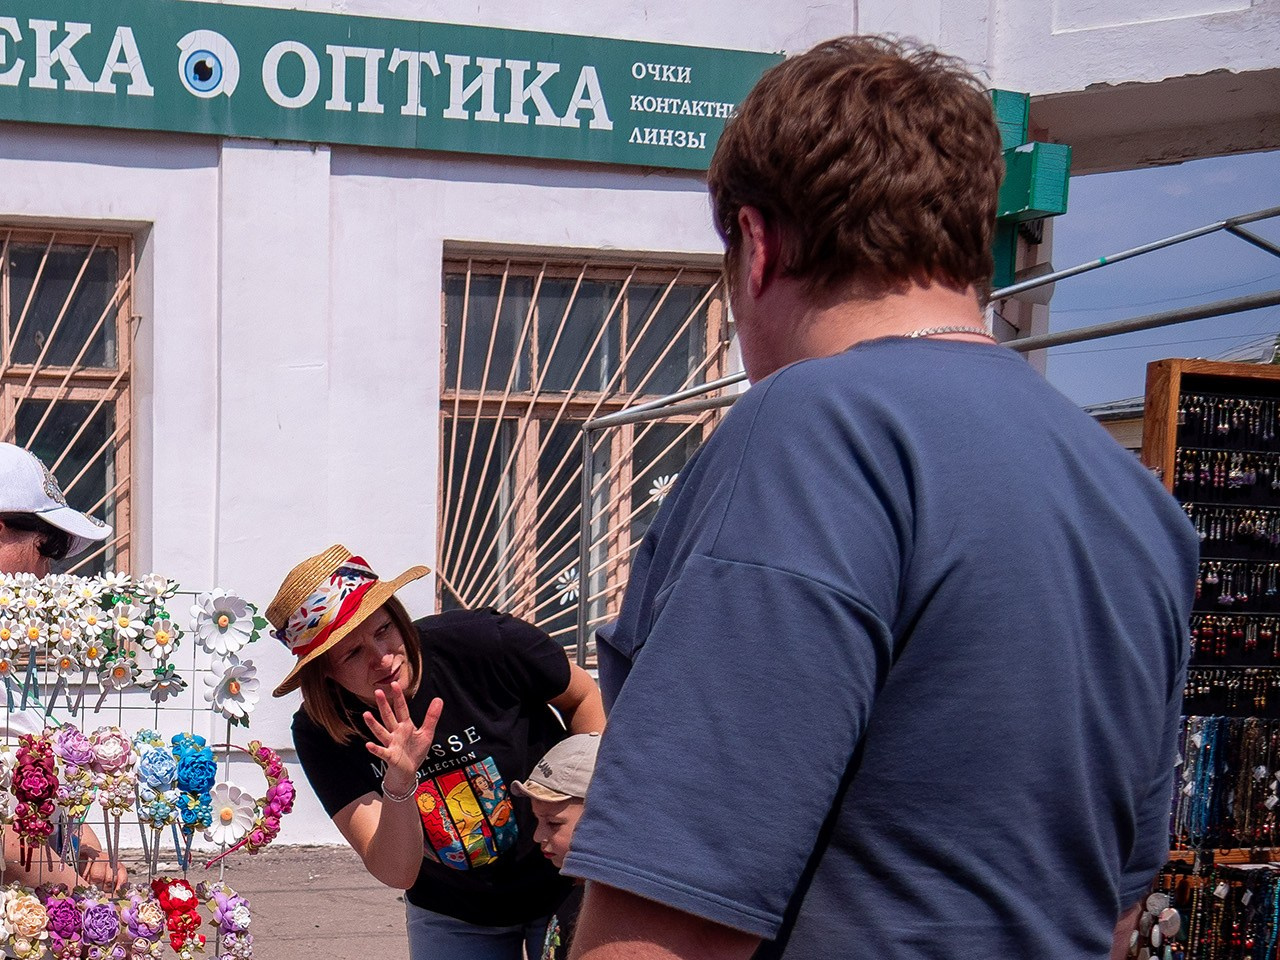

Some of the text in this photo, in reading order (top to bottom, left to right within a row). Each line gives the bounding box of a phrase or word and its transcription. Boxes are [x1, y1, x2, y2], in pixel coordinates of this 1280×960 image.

[262, 40, 613, 131] ОПТИКА
[631, 62, 692, 83] ОЧКИ
[630, 95, 738, 119] КОНТАКТН
[628, 127, 706, 149] ЛИНЗЫ
[370, 726, 481, 778] MSSE
[415, 751, 477, 779] OLLECTION
